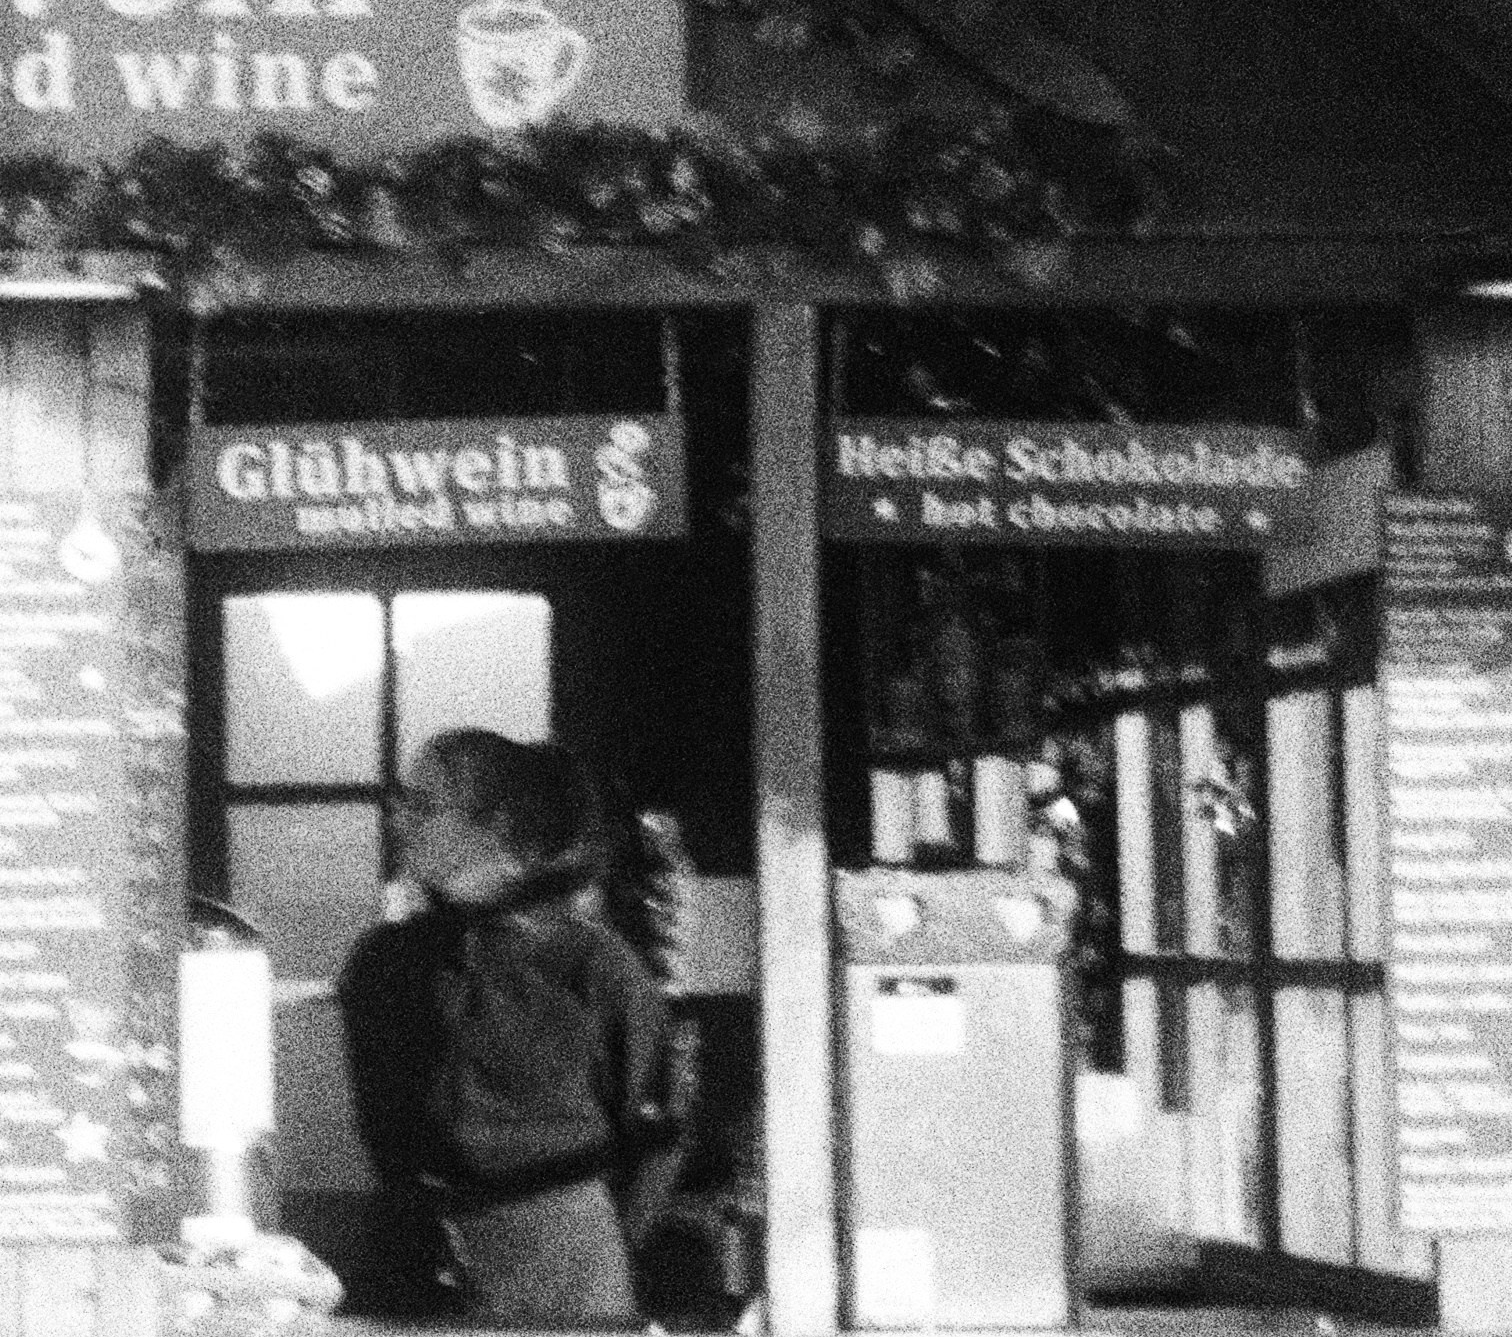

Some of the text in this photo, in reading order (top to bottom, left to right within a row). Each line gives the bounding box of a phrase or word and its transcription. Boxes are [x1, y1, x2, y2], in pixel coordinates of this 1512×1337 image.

[114, 32, 378, 112] wine
[216, 434, 570, 502] Glühwein
[836, 433, 1307, 490] Heiße Schokolade
[295, 492, 576, 535] mulled wine
[921, 490, 1223, 533] hot chocolate
